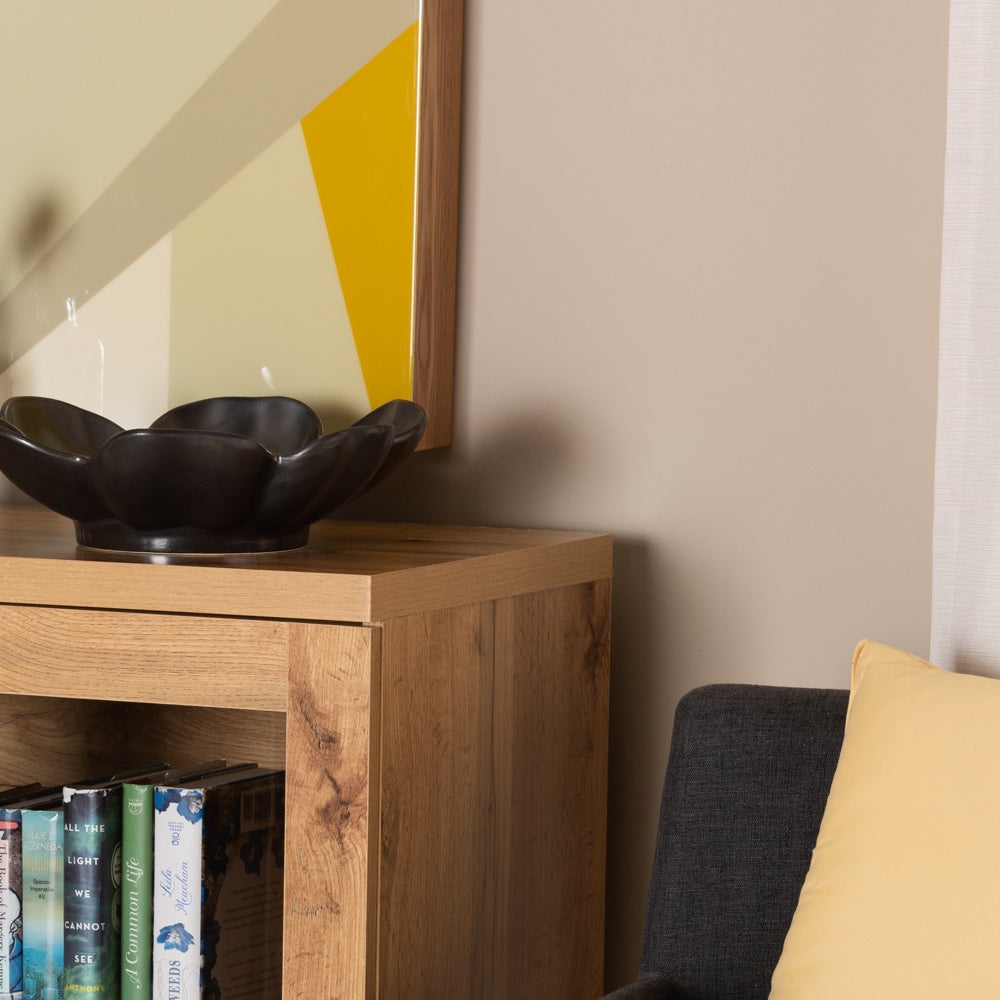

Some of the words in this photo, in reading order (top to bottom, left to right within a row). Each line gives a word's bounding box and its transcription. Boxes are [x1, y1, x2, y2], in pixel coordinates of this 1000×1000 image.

[64, 823, 80, 832] ALL
[84, 824, 105, 833] THE
[67, 855, 100, 866] LIGHT
[125, 857, 144, 888] Life
[74, 889, 91, 898] WE
[175, 860, 193, 916] Meacham
[64, 919, 106, 931] CANNOT
[124, 891, 141, 968] Common
[74, 954, 94, 964] SEE
[127, 968, 144, 990] A
[64, 983, 105, 993] ANTHONY
